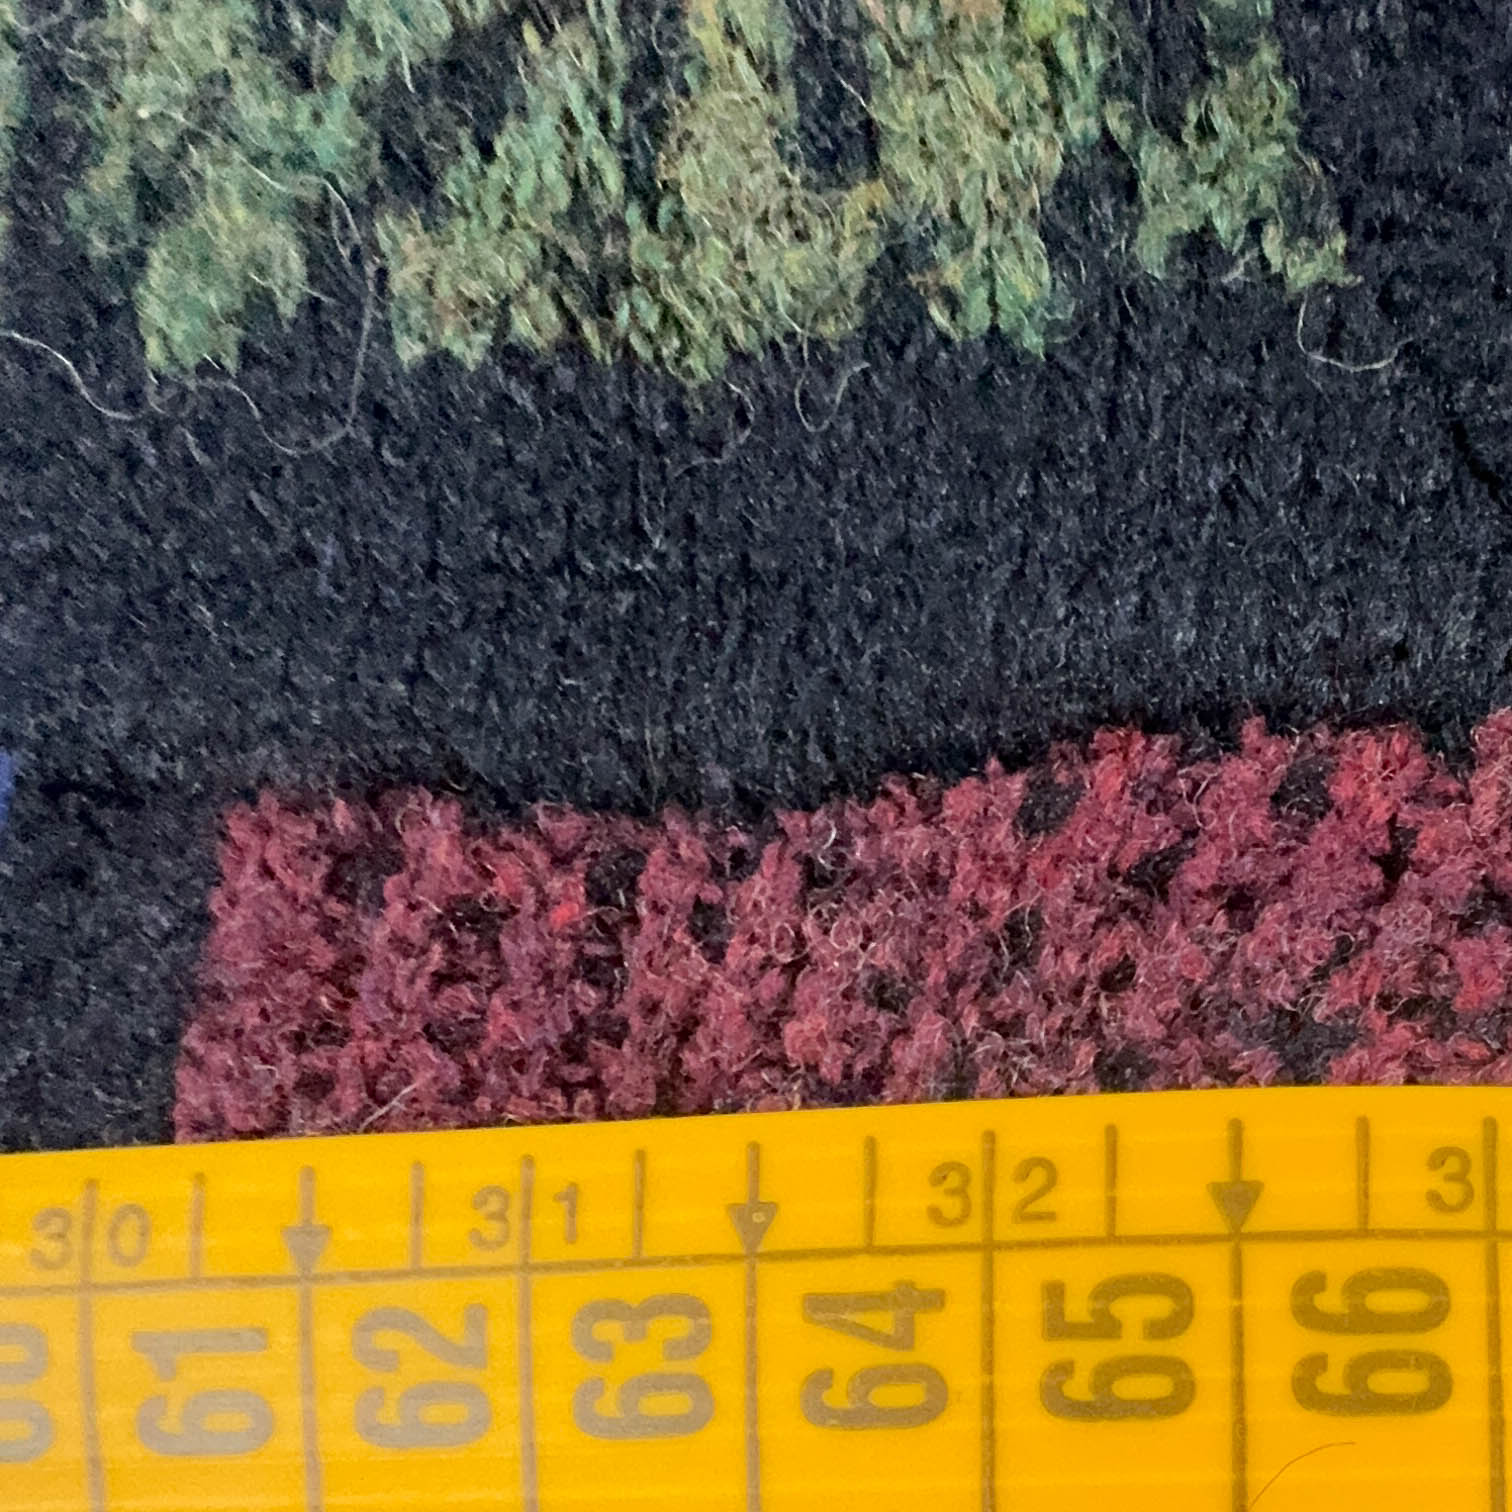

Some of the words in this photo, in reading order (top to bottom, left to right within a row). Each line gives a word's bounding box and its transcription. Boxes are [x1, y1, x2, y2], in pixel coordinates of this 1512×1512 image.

[30, 1203, 150, 1271] 30
[469, 1182, 580, 1250] 31
[926, 1157, 1059, 1228] 32
[131, 1327, 274, 1456] 61
[351, 1303, 493, 1450] 62
[570, 1292, 715, 1441] 63
[800, 1279, 949, 1430] 64
[1039, 1272, 1197, 1423] 65
[1290, 1266, 1453, 1418] 66
